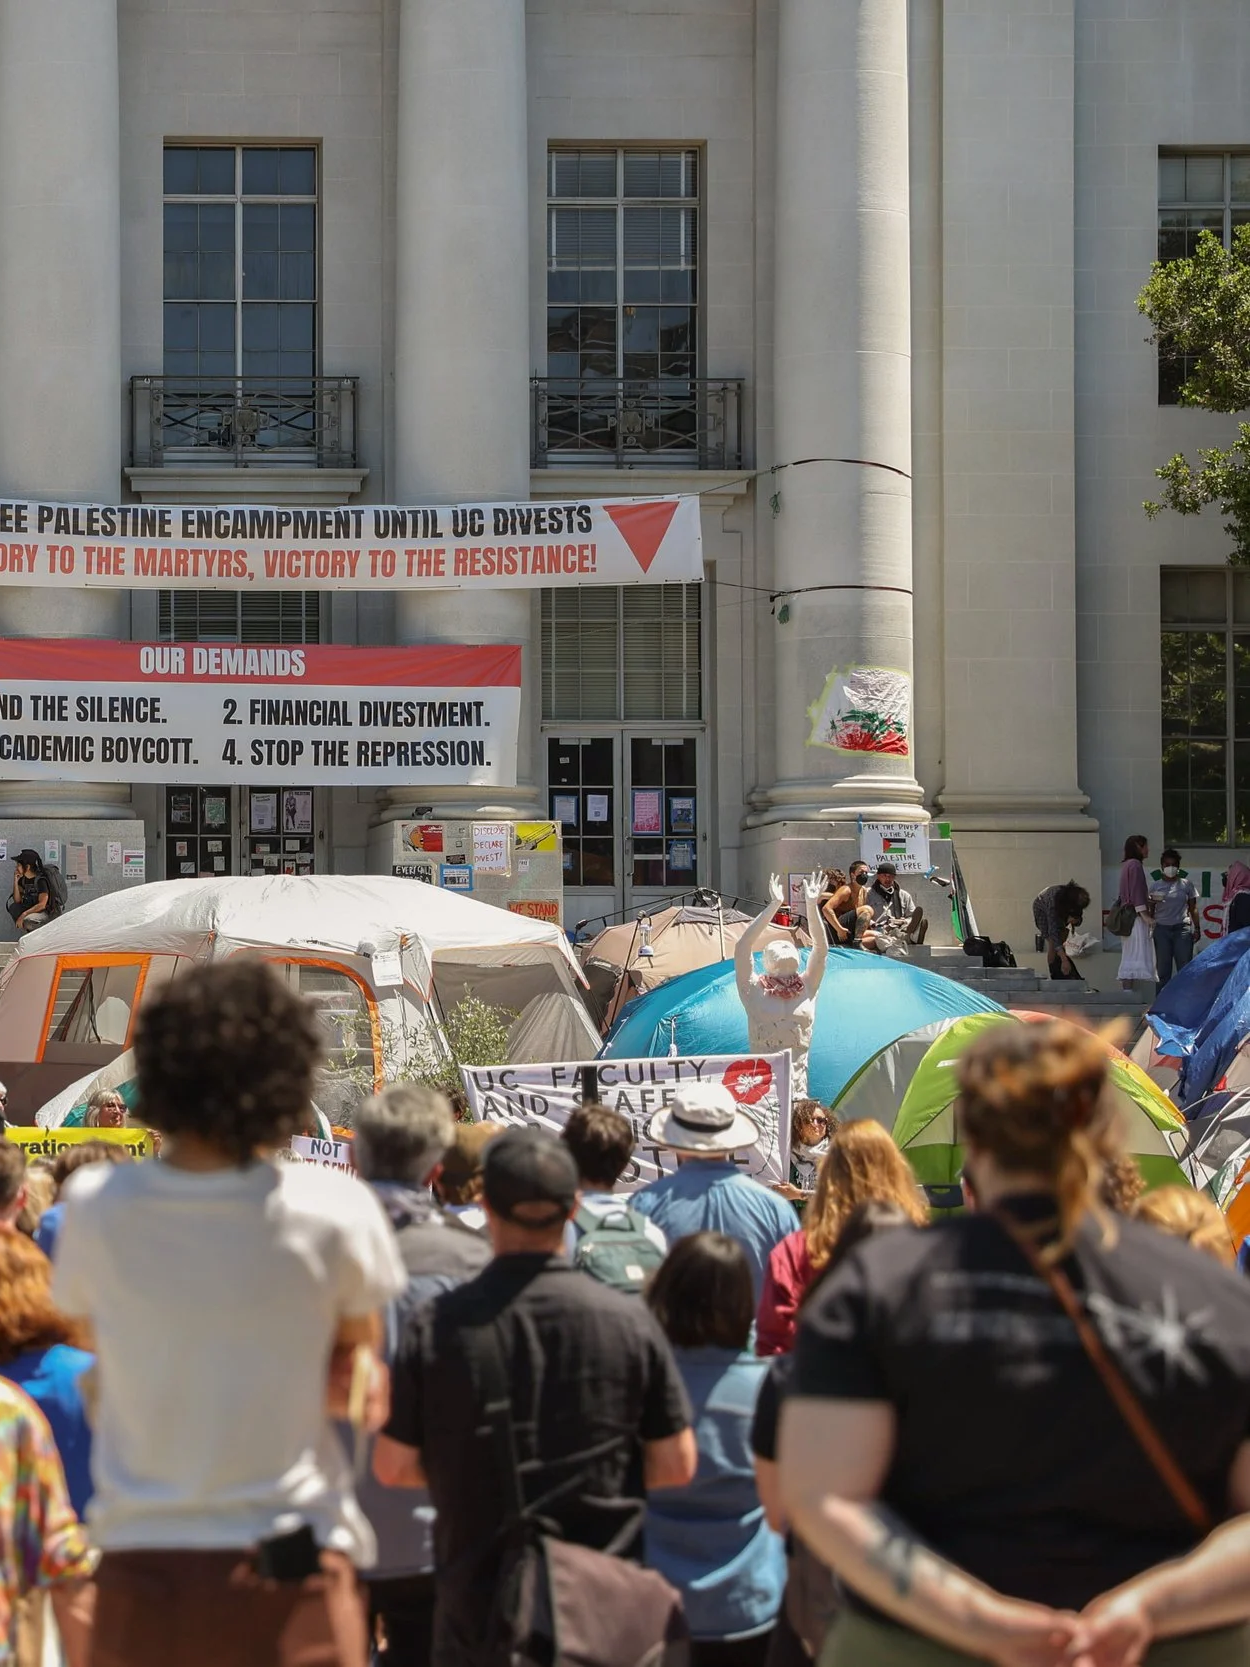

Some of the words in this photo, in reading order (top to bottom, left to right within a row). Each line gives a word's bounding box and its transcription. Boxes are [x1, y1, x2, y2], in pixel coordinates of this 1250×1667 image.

[38, 505, 172, 539] PALESTINE
[181, 508, 365, 540] ENCAMPMENT
[374, 508, 443, 540] UNTIL
[452, 508, 485, 539] UC
[493, 504, 593, 537] DIVESTS
[46, 544, 75, 574] TO
[83, 546, 126, 576] THE
[133, 547, 255, 581] MARTYRS,
[263, 549, 360, 579] VICTORY
[368, 549, 396, 578] TO
[404, 548, 446, 577] THE
[454, 543, 597, 577] RESISTANCE!
[139, 646, 186, 675] OUR
[192, 647, 306, 677] DEMANDS
[29, 694, 69, 722] THE
[75, 695, 168, 724] SILENCE.
[222, 698, 243, 725] 2.
[249, 698, 353, 727] FINANCIAL
[359, 700, 491, 728] DIVESTMENT.
[101, 736, 199, 765] BOYCOTT.
[221, 738, 243, 765] 4.
[249, 738, 304, 766] STOP
[310, 740, 349, 767] THE
[356, 740, 492, 767] REPRESSION.
[473, 826, 505, 837] DISCLOSE
[882, 823, 895, 831] THE
[473, 840, 504, 850] DECLARE
[527, 902, 558, 917] STAND
[476, 1069, 518, 1092] UC
[482, 1094, 549, 1121] AND
[310, 1139, 342, 1159] NOT
